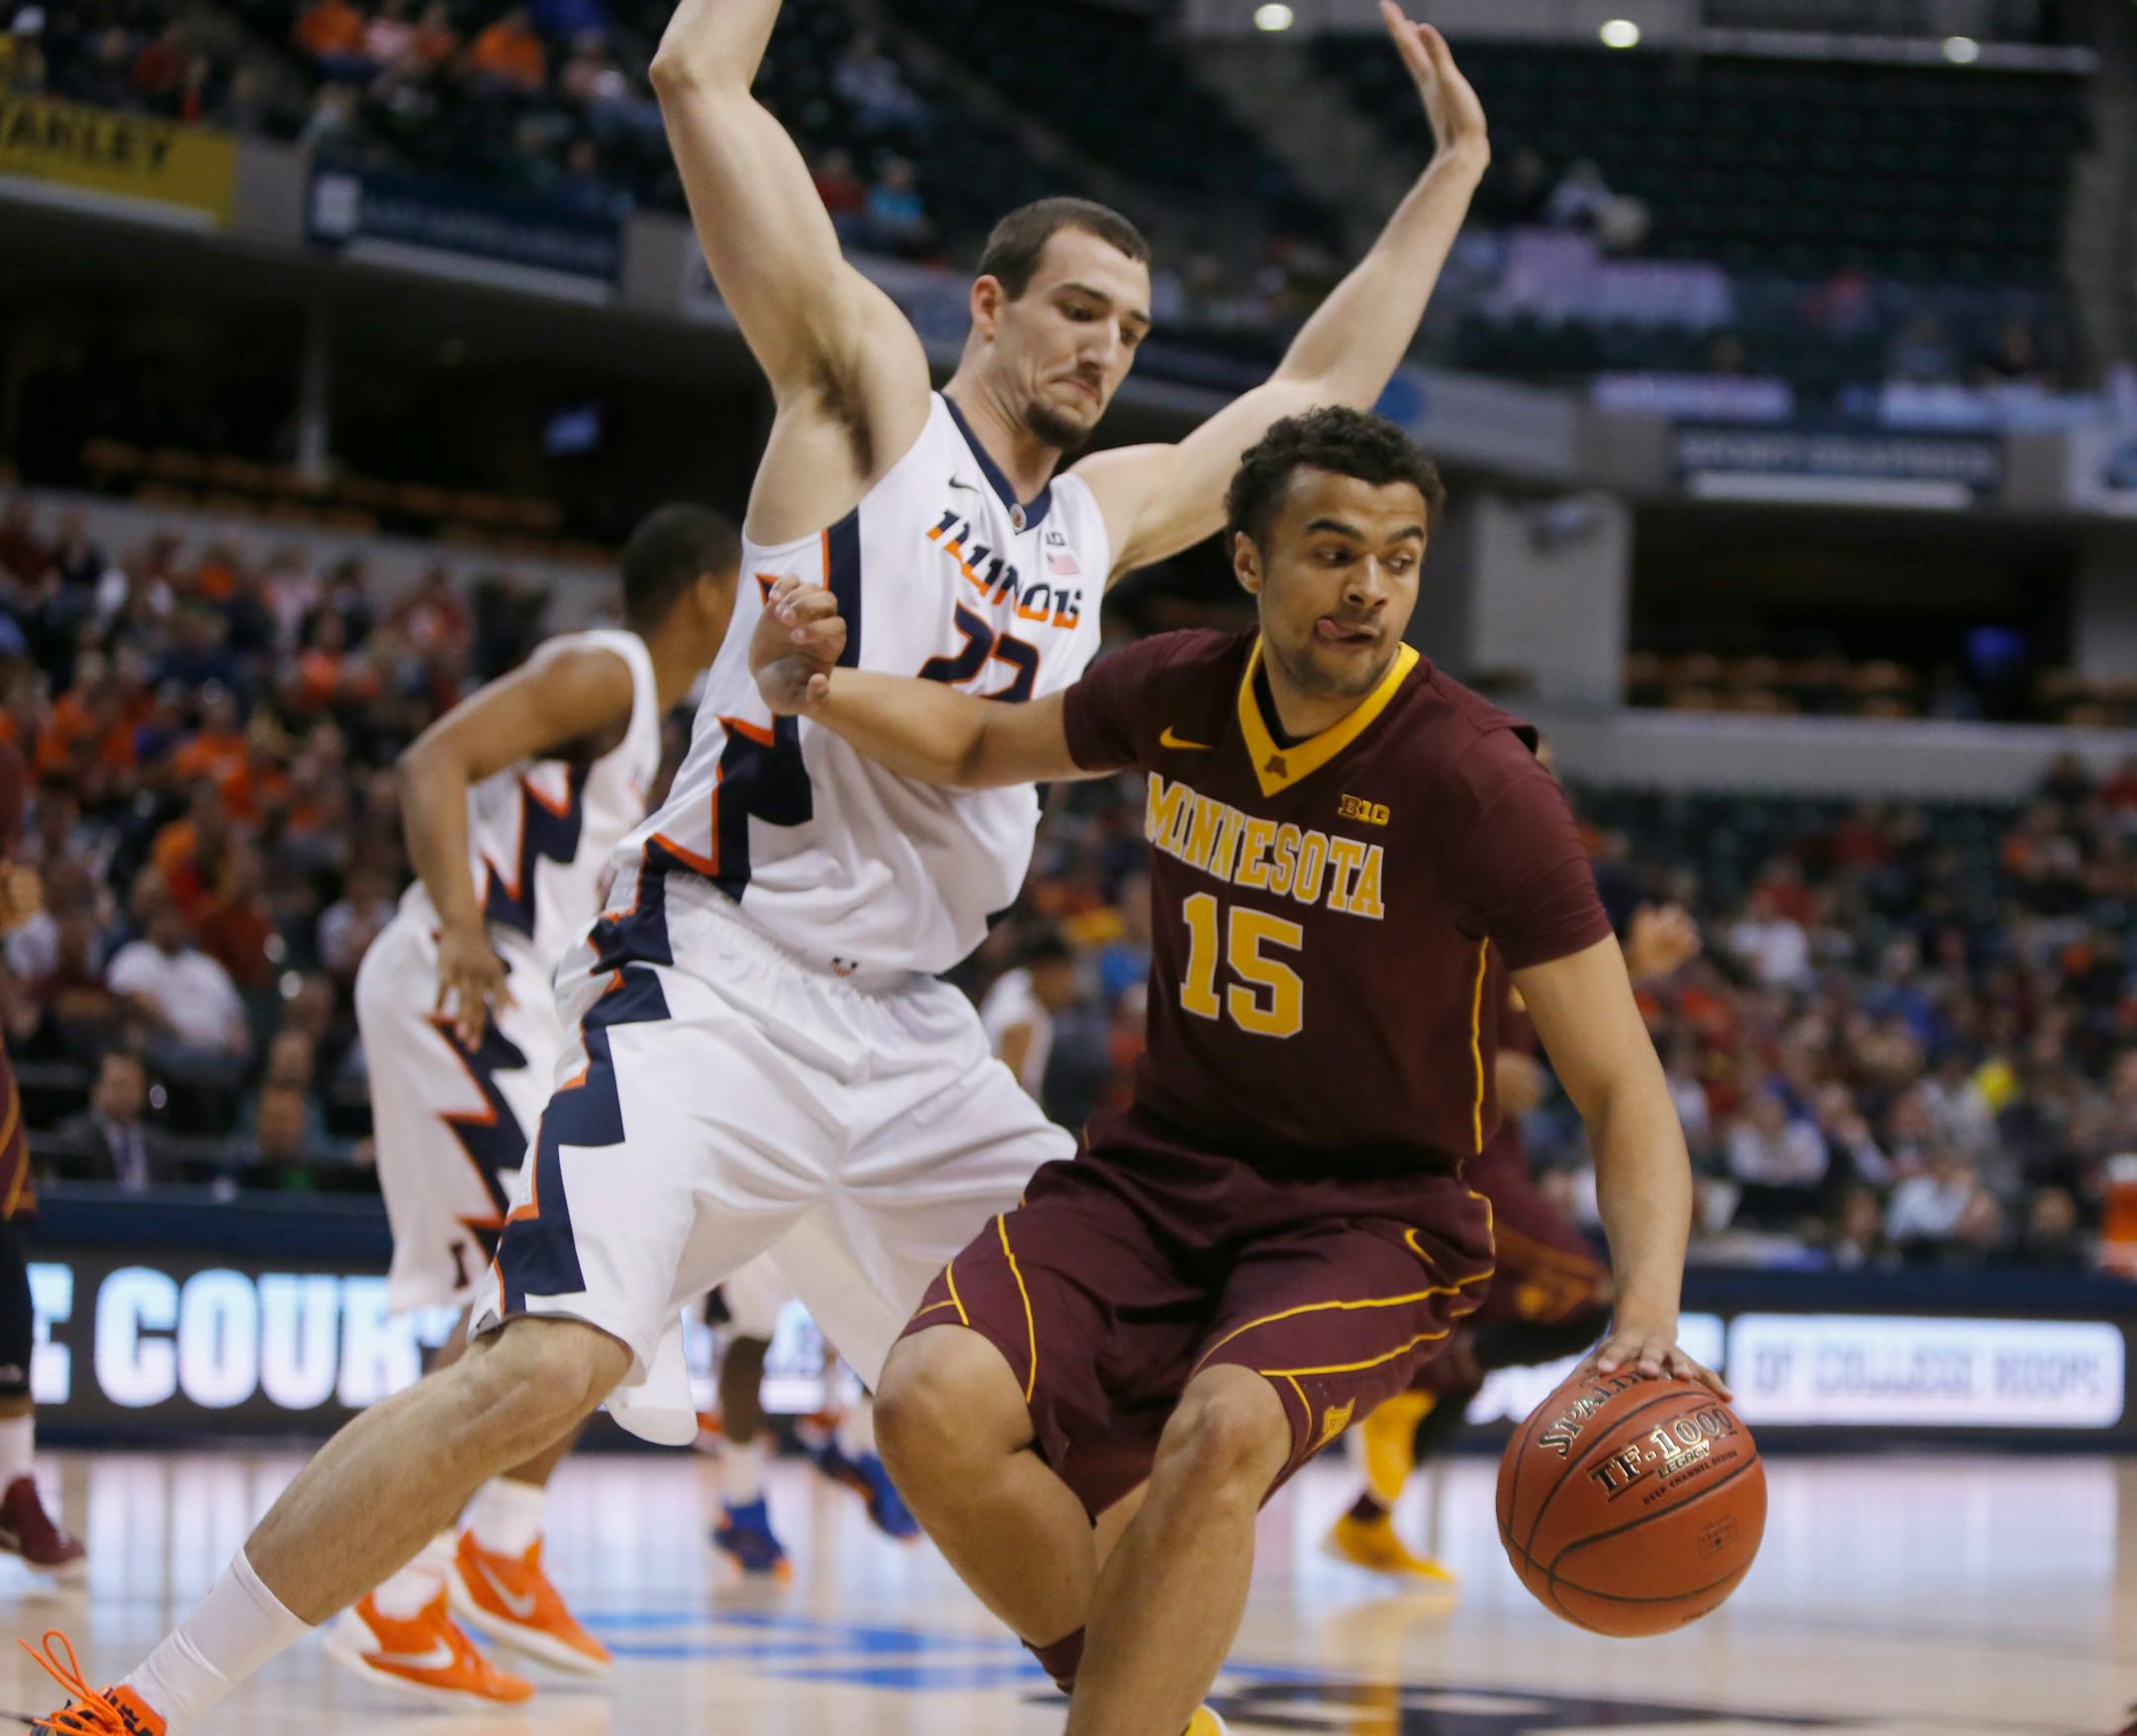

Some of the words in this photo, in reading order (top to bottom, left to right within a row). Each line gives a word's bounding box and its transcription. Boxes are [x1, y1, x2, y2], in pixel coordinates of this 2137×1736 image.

[1145, 771, 1385, 920] MINNESOTA
[1180, 891, 1304, 1039] 15
[94, 1265, 462, 1411] COUR
[1642, 1487, 1667, 1505] DEEP
[1669, 1462, 1711, 1489] CHANNEL
[1657, 1440, 1711, 1479] LEGACY
